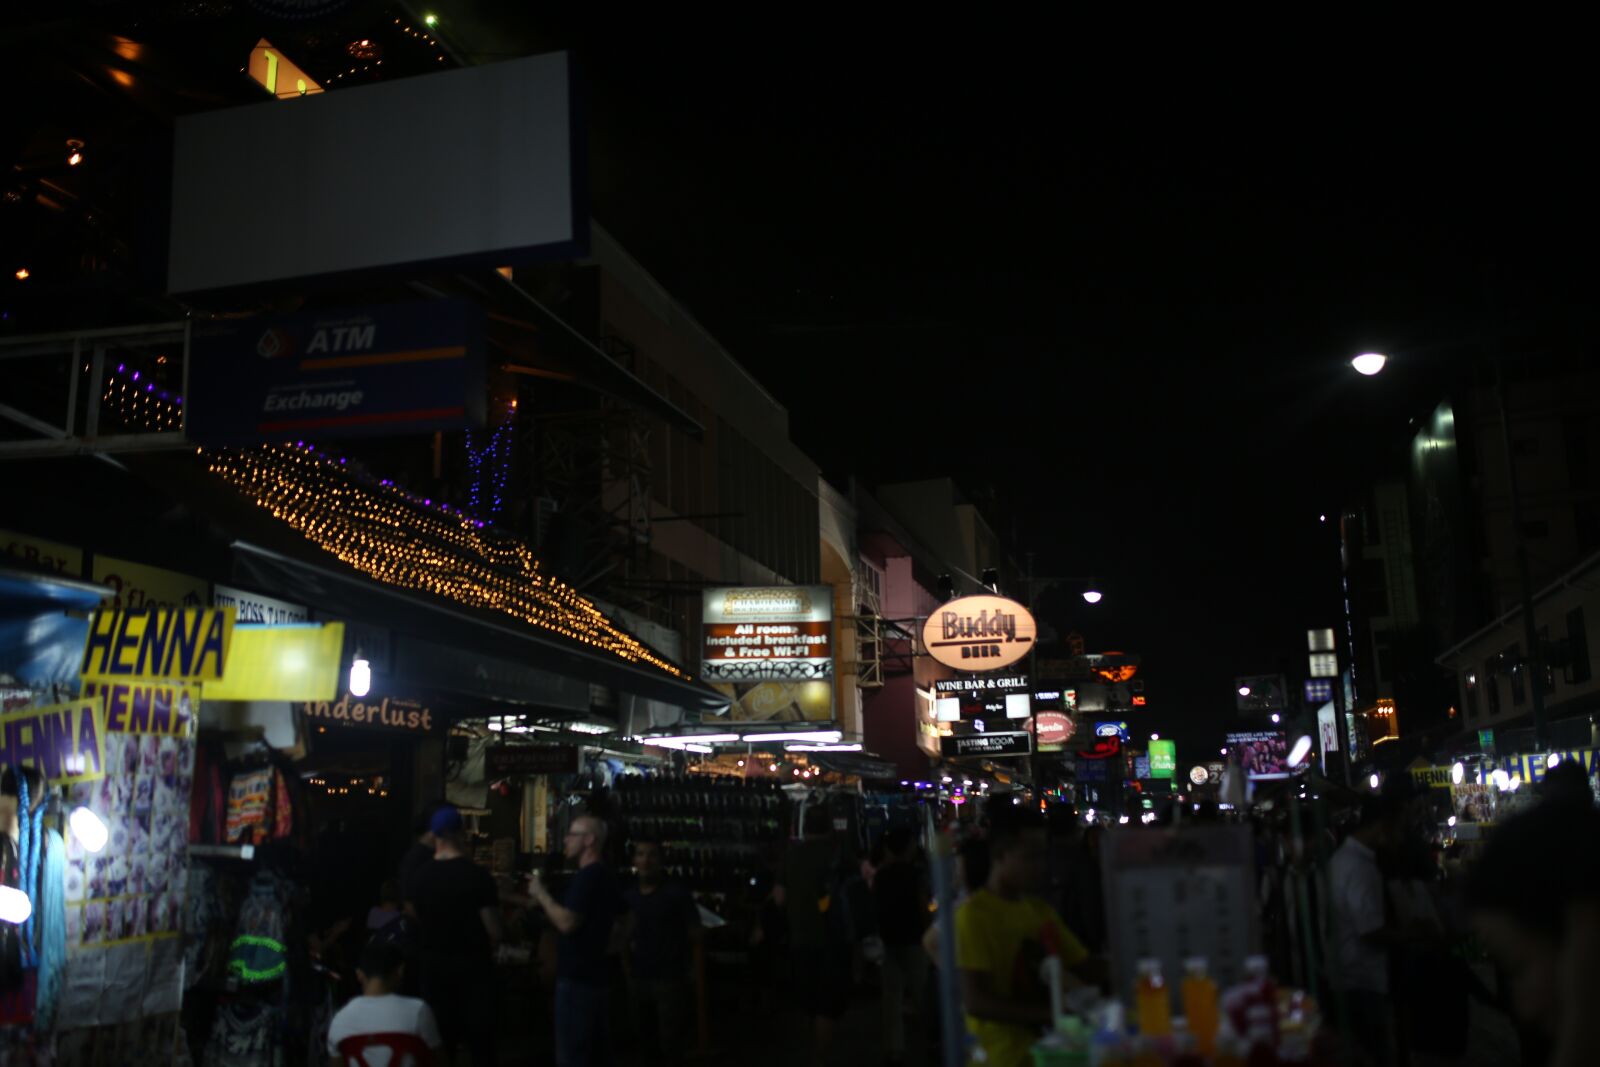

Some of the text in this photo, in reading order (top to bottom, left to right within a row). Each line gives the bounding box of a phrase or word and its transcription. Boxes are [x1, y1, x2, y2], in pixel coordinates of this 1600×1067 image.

[306, 325, 376, 354] ATM
[263, 389, 364, 412] Exchange
[240, 600, 265, 624] BOSS
[735, 624, 799, 635] All rooms
[942, 609, 1016, 642] Buddy
[82, 609, 224, 677] HENNA
[764, 634, 828, 645] breakfast
[724, 647, 736, 657] &
[739, 647, 771, 657] Free
[961, 645, 1001, 659] BEER
[936, 676, 1028, 691] WINE BAR & GRILL
[1414, 770, 1453, 785] HENN
